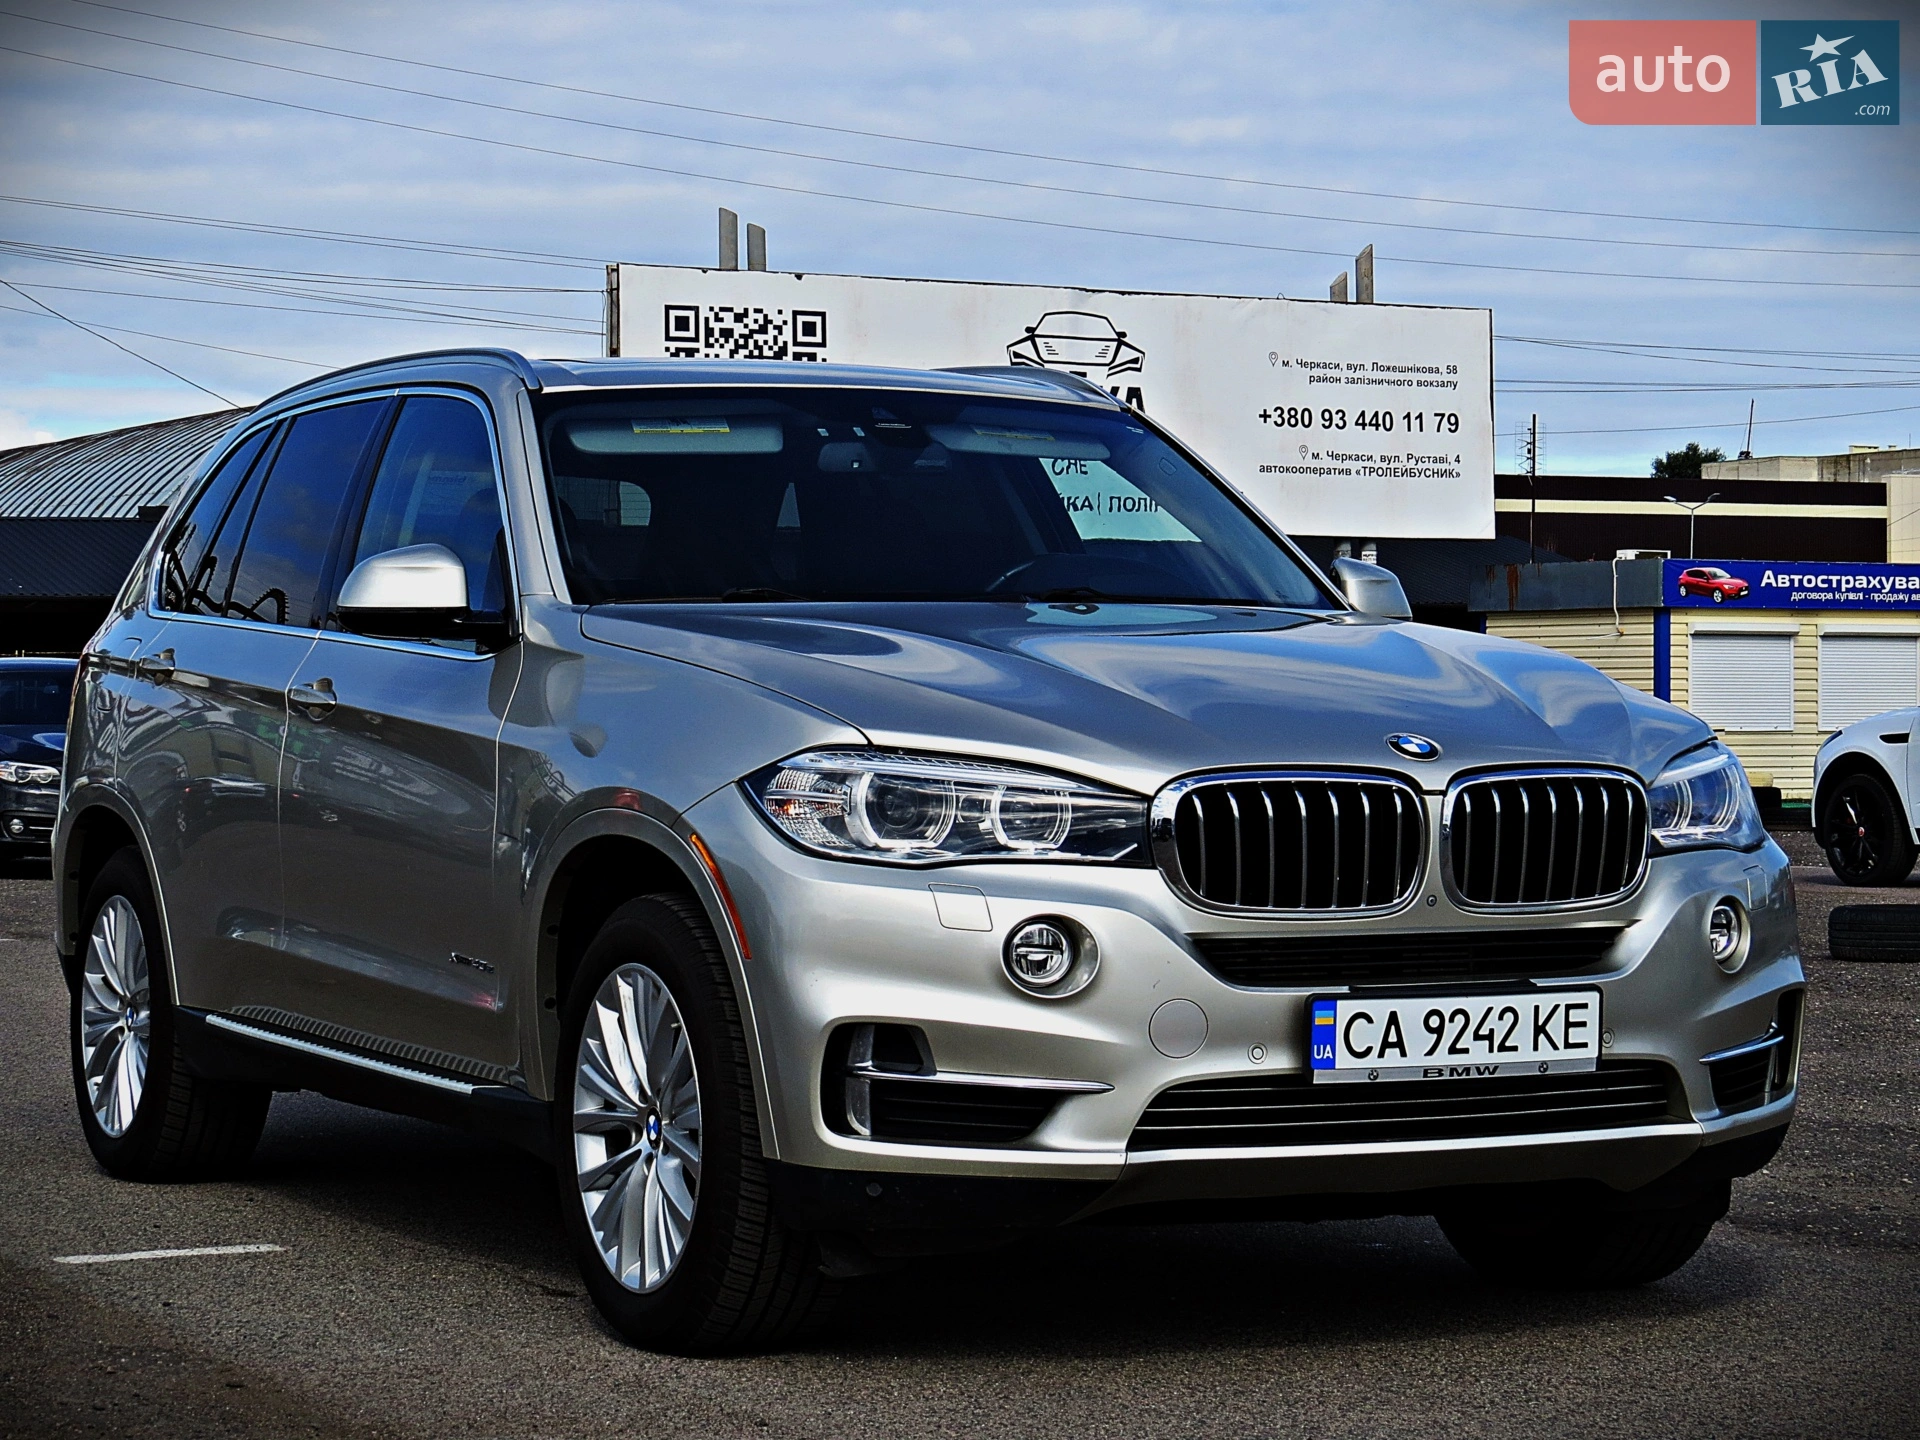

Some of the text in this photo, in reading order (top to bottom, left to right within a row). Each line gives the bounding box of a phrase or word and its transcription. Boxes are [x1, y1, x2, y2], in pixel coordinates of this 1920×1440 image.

[1281, 358, 1458, 376] м. Черкаси, вул. Ложешнікова, 58
[1308, 373, 1459, 391] район залізничного вокзалу
[1258, 405, 1460, 434] +380 93 440 11 79
[1311, 450, 1461, 467] м. Черкаси, вул. Руставі, 4
[1258, 464, 1461, 480] автокооператив «ТРОЛЕЙБУСНИК»
[1760, 570, 1920, 593] Автострахува
[1790, 591, 1834, 602] договора
[1870, 592, 1909, 603] продажу
[1343, 1002, 1589, 1059] CA 9242 KE
[1313, 1044, 1334, 1060] UA
[1422, 1064, 1500, 1079] BMW
